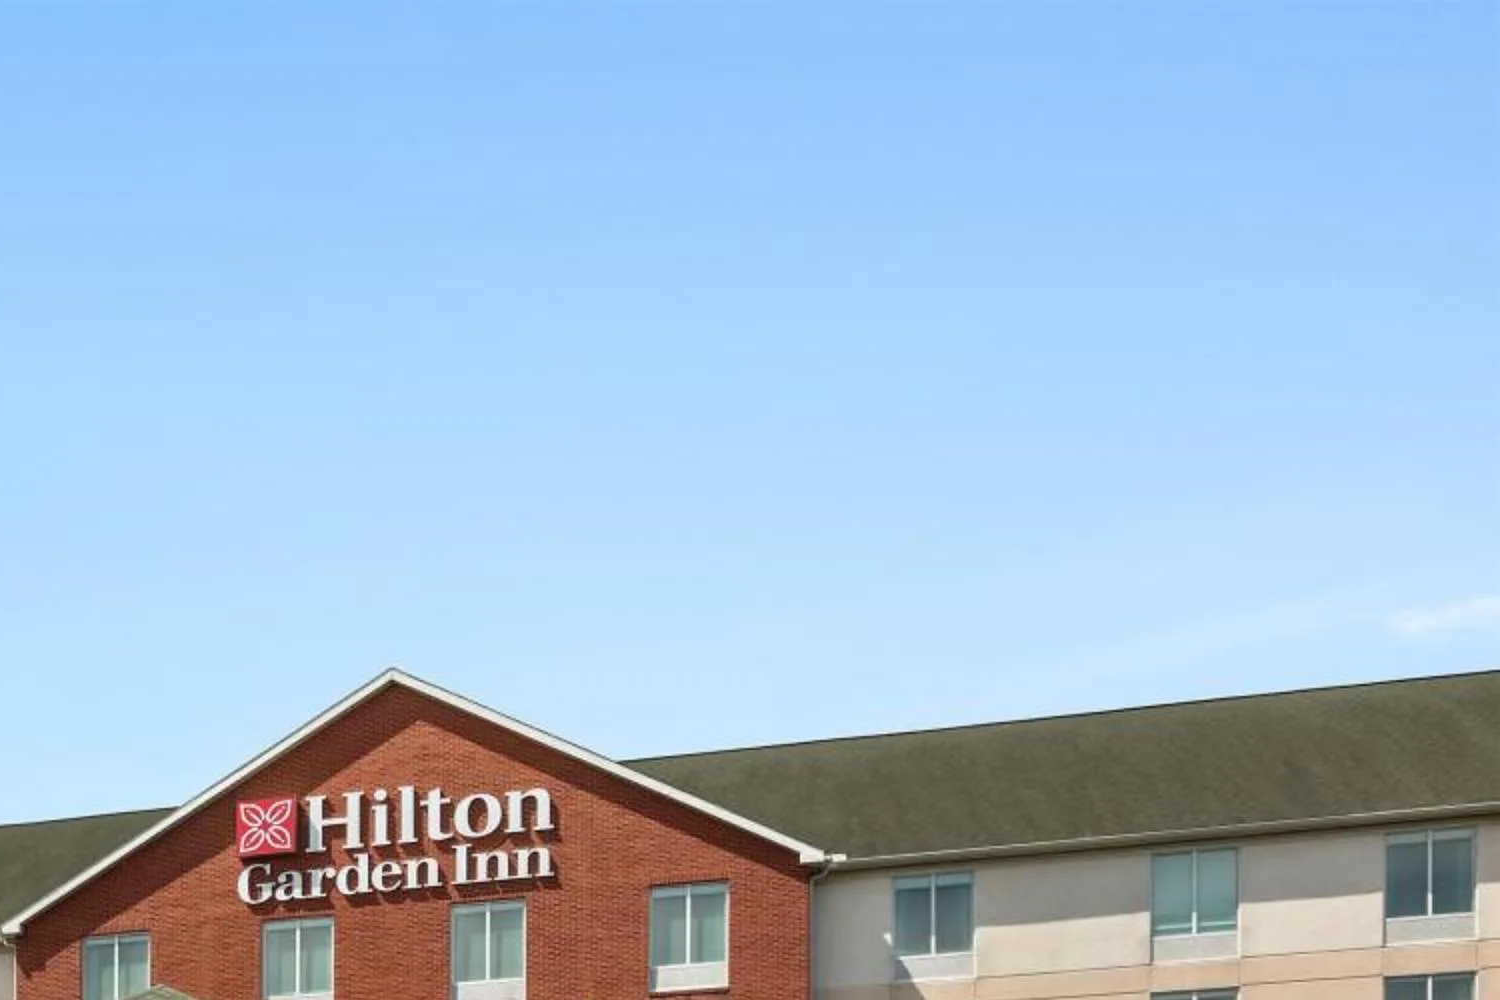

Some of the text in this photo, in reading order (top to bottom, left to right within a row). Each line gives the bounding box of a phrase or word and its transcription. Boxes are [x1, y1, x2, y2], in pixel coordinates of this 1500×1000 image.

[305, 785, 554, 853] Hilton
[237, 843, 554, 904] Garden Inn
